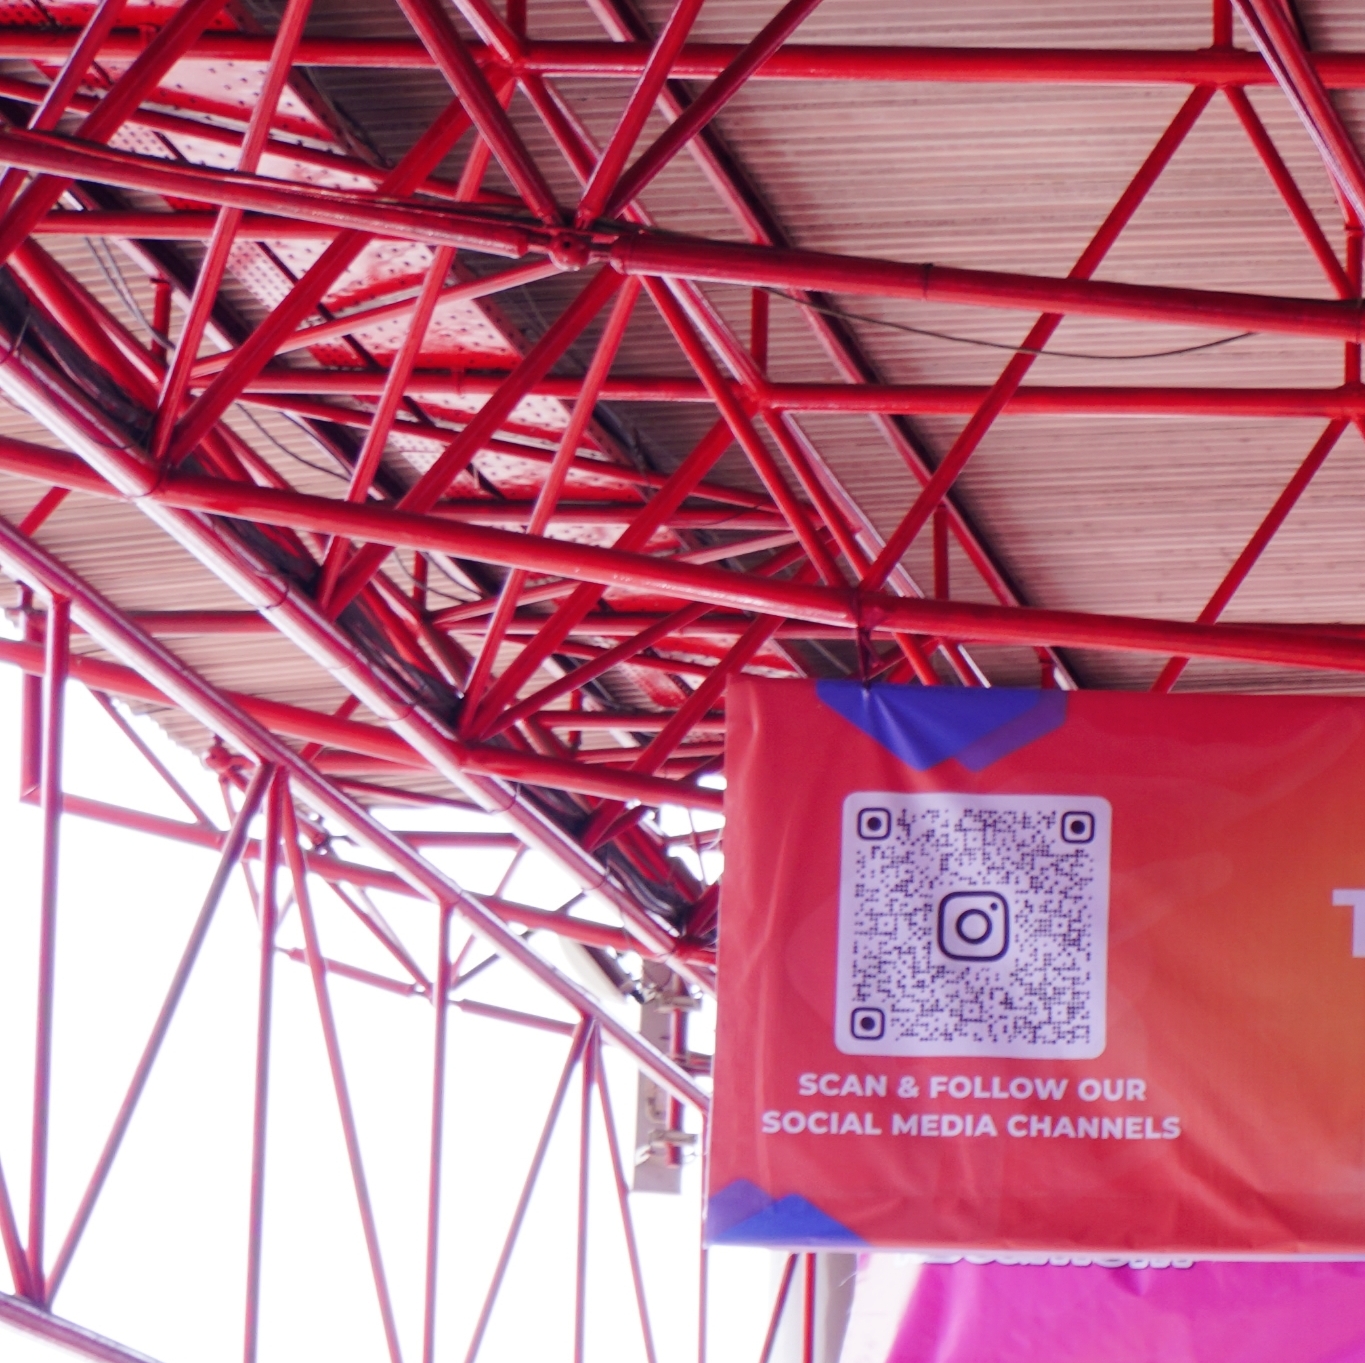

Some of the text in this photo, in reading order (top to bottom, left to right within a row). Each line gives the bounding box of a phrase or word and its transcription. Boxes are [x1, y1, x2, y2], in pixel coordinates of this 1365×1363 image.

[798, 1073, 1147, 1102] SCAN & FOLLOW OUR
[761, 1110, 1182, 1141] SOCIAL MEDIA CHANNELS
